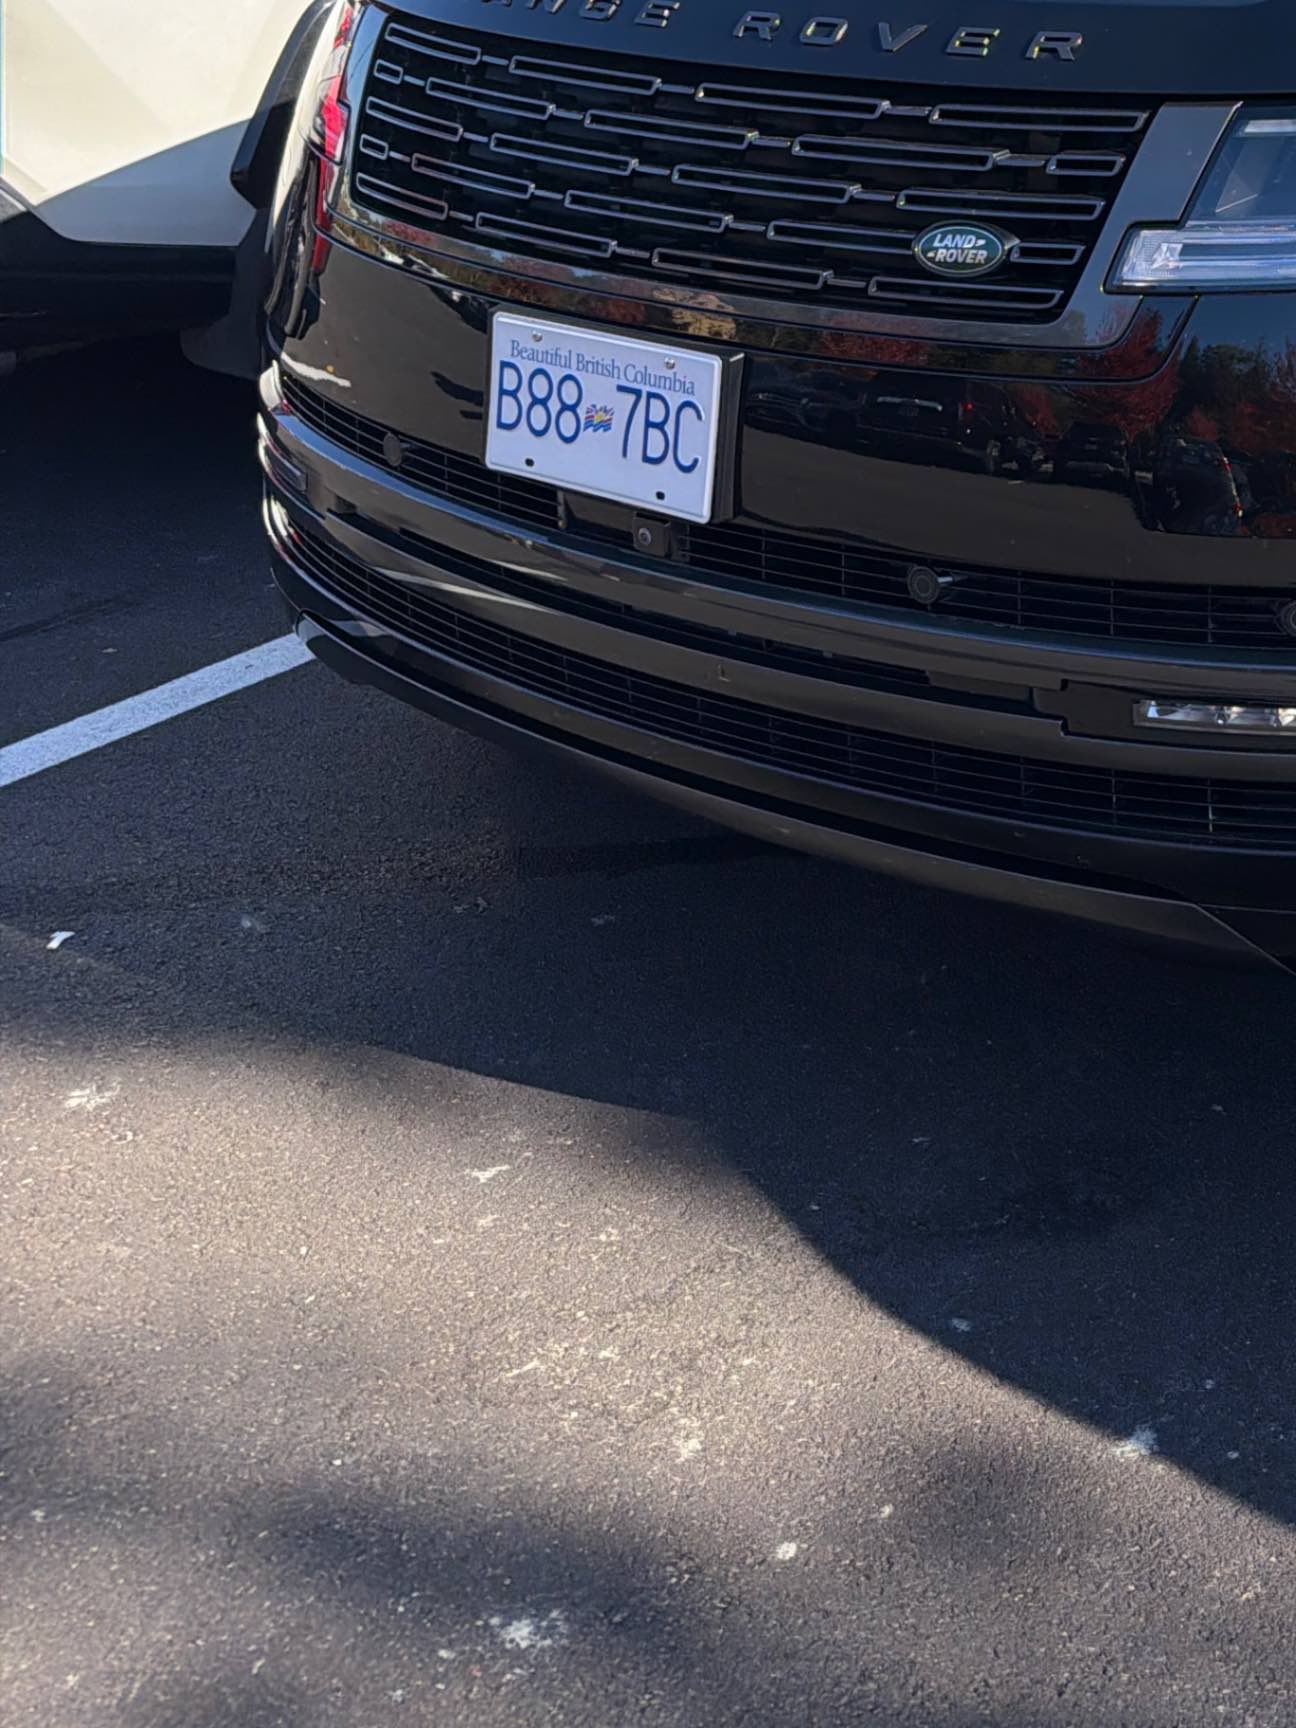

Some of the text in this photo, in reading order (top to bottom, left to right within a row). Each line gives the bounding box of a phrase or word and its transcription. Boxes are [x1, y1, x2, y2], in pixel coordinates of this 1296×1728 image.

[732, 10, 1085, 61] ROVER
[933, 234, 976, 248] LAND
[935, 249, 988, 264] ROVER
[510, 339, 696, 396] Beautiful British Columbia
[496, 360, 706, 474] B88 7BC
